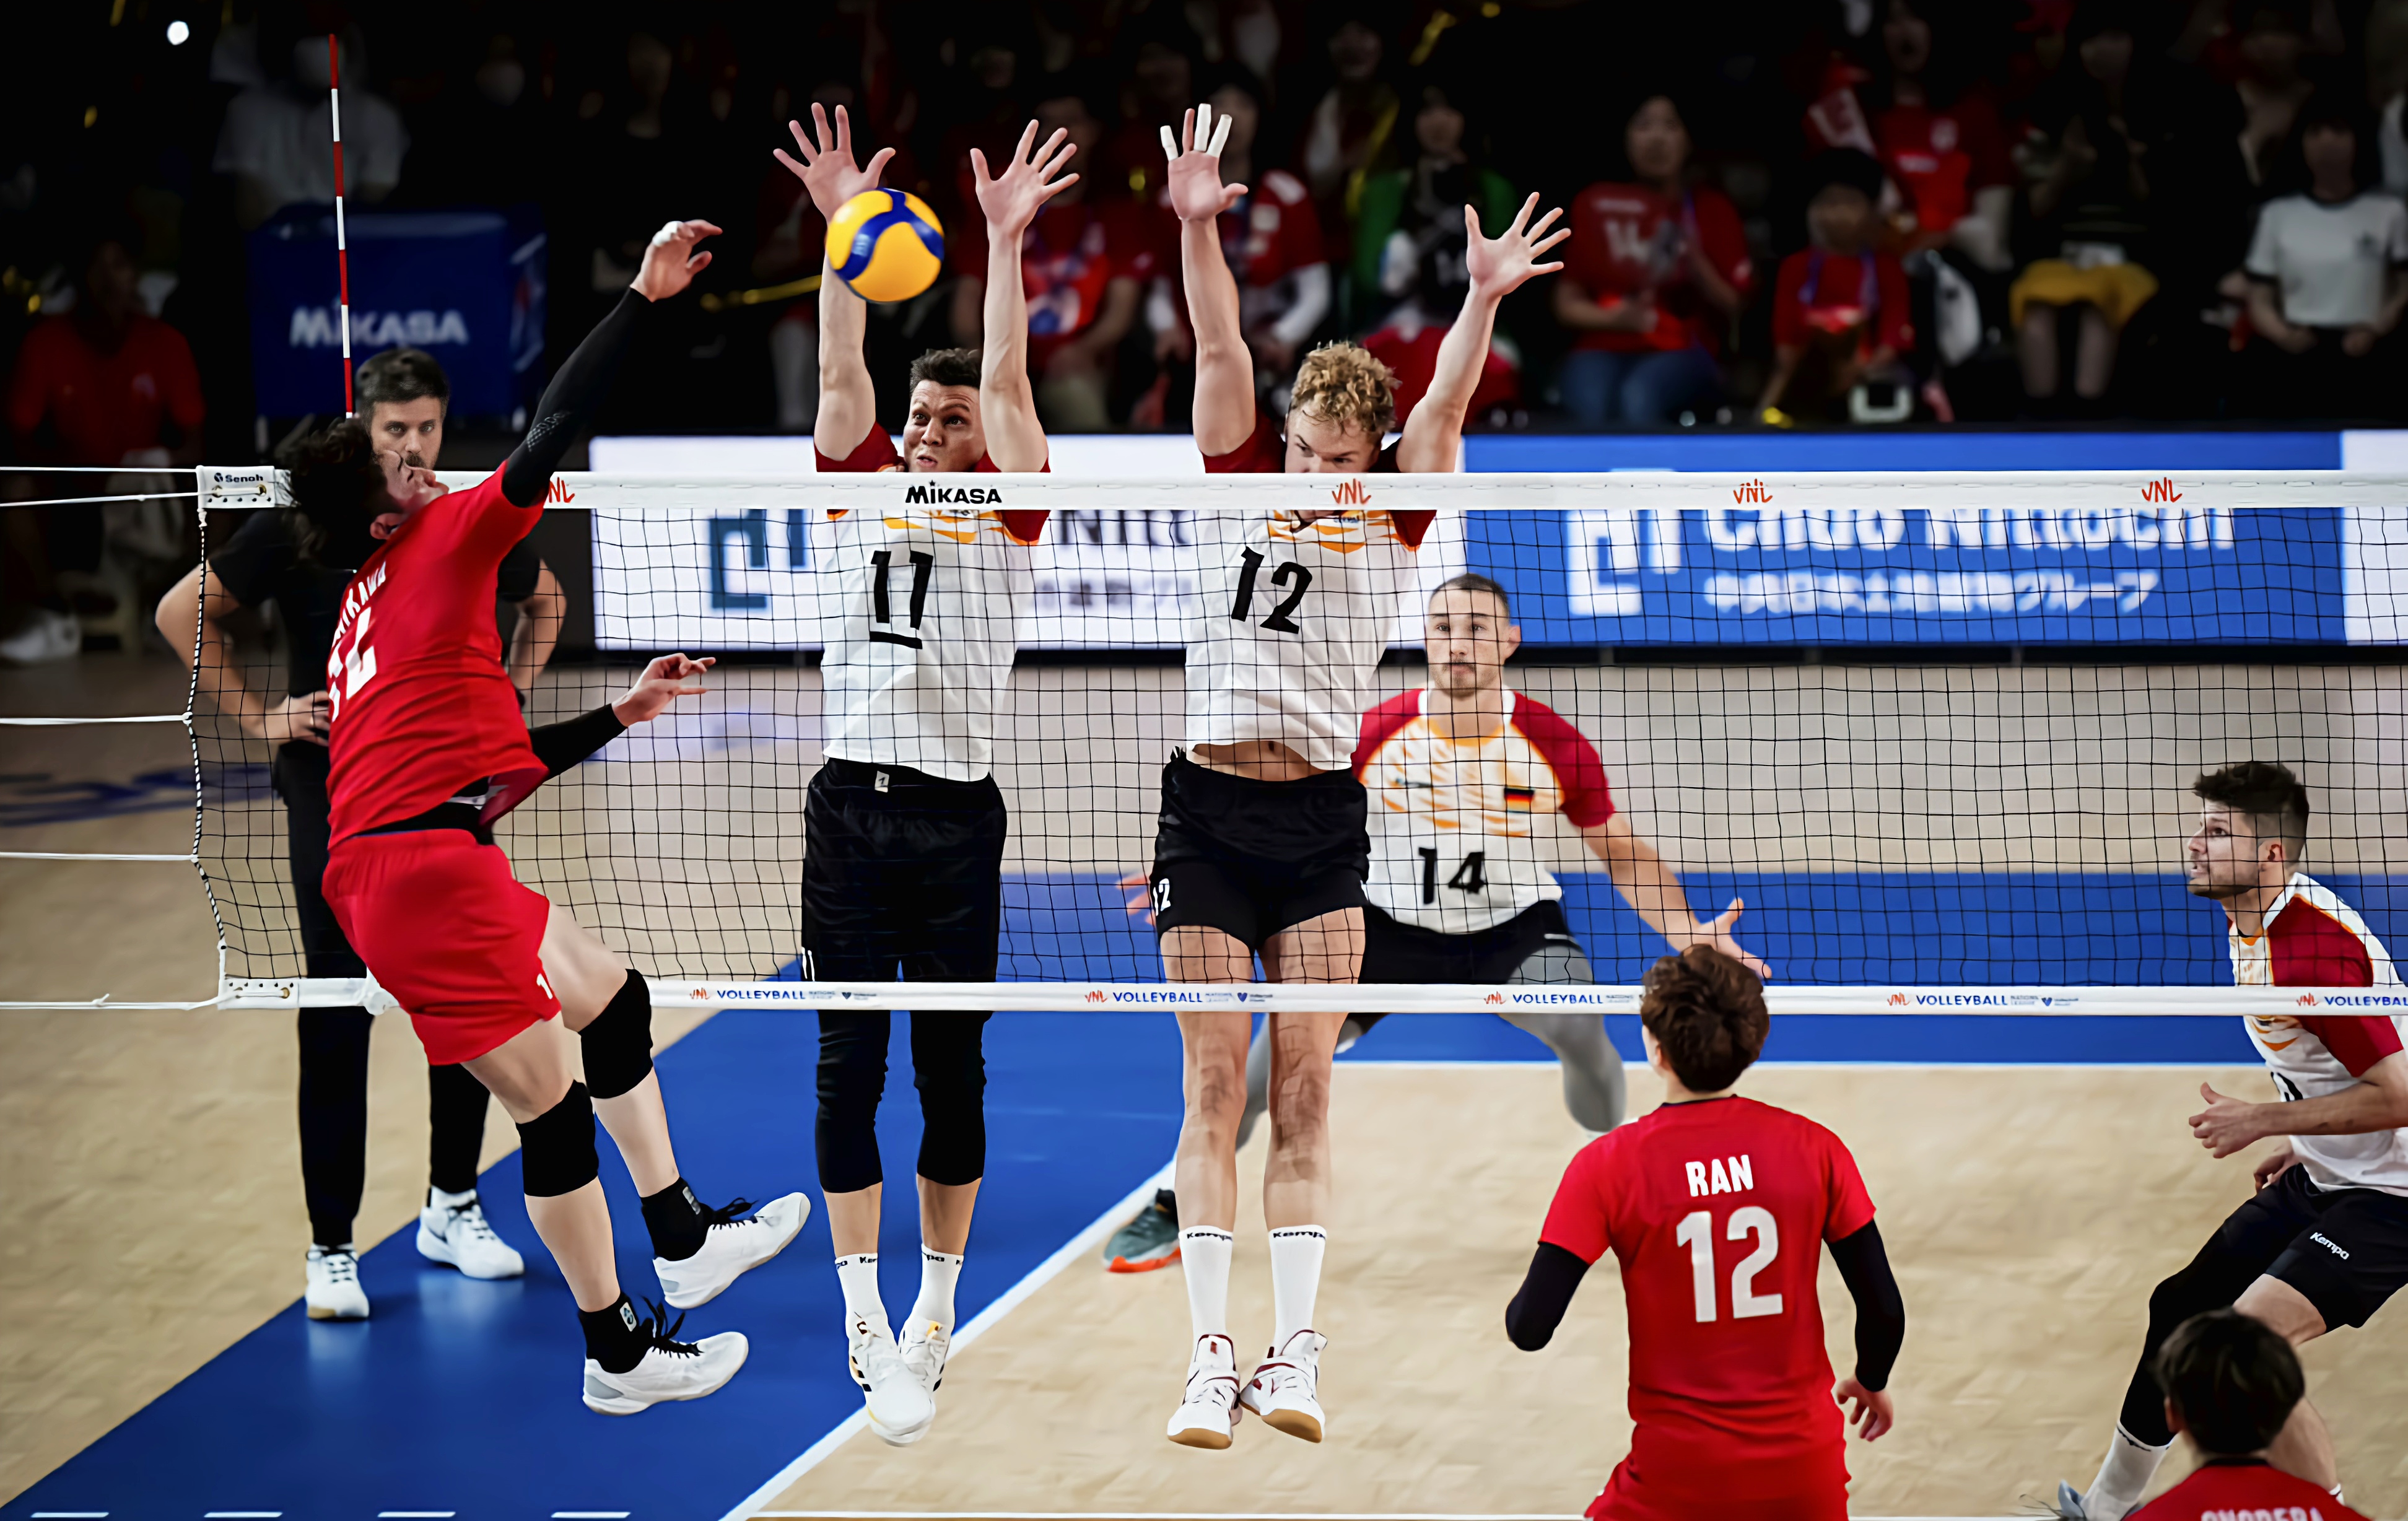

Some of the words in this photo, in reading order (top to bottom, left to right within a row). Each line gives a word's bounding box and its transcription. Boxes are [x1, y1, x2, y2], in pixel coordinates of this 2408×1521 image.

[225, 474, 263, 482] Senoh
[549, 477, 575, 503] NL
[1331, 478, 1372, 504] VNL
[1733, 478, 1773, 504] VNL
[2141, 477, 2183, 503] VNL
[1231, 546, 1313, 635] 12
[1418, 847, 1486, 905] 14
[1153, 878, 1171, 917] 12
[717, 990, 806, 1000] VOLLEYBALL
[1113, 992, 1203, 1003] VOLLEYBALL
[1512, 994, 1603, 1004] VOLLEYBALL
[1916, 995, 2008, 1006] VOLLEYBALL
[2324, 996, 2408, 1006] VOLLEYBAL
[1685, 1154, 1753, 1197] RAN
[1273, 1231, 1326, 1240] Kemp
[2310, 1231, 2350, 1260] Kempa
[1676, 1206, 1783, 1323] 12
